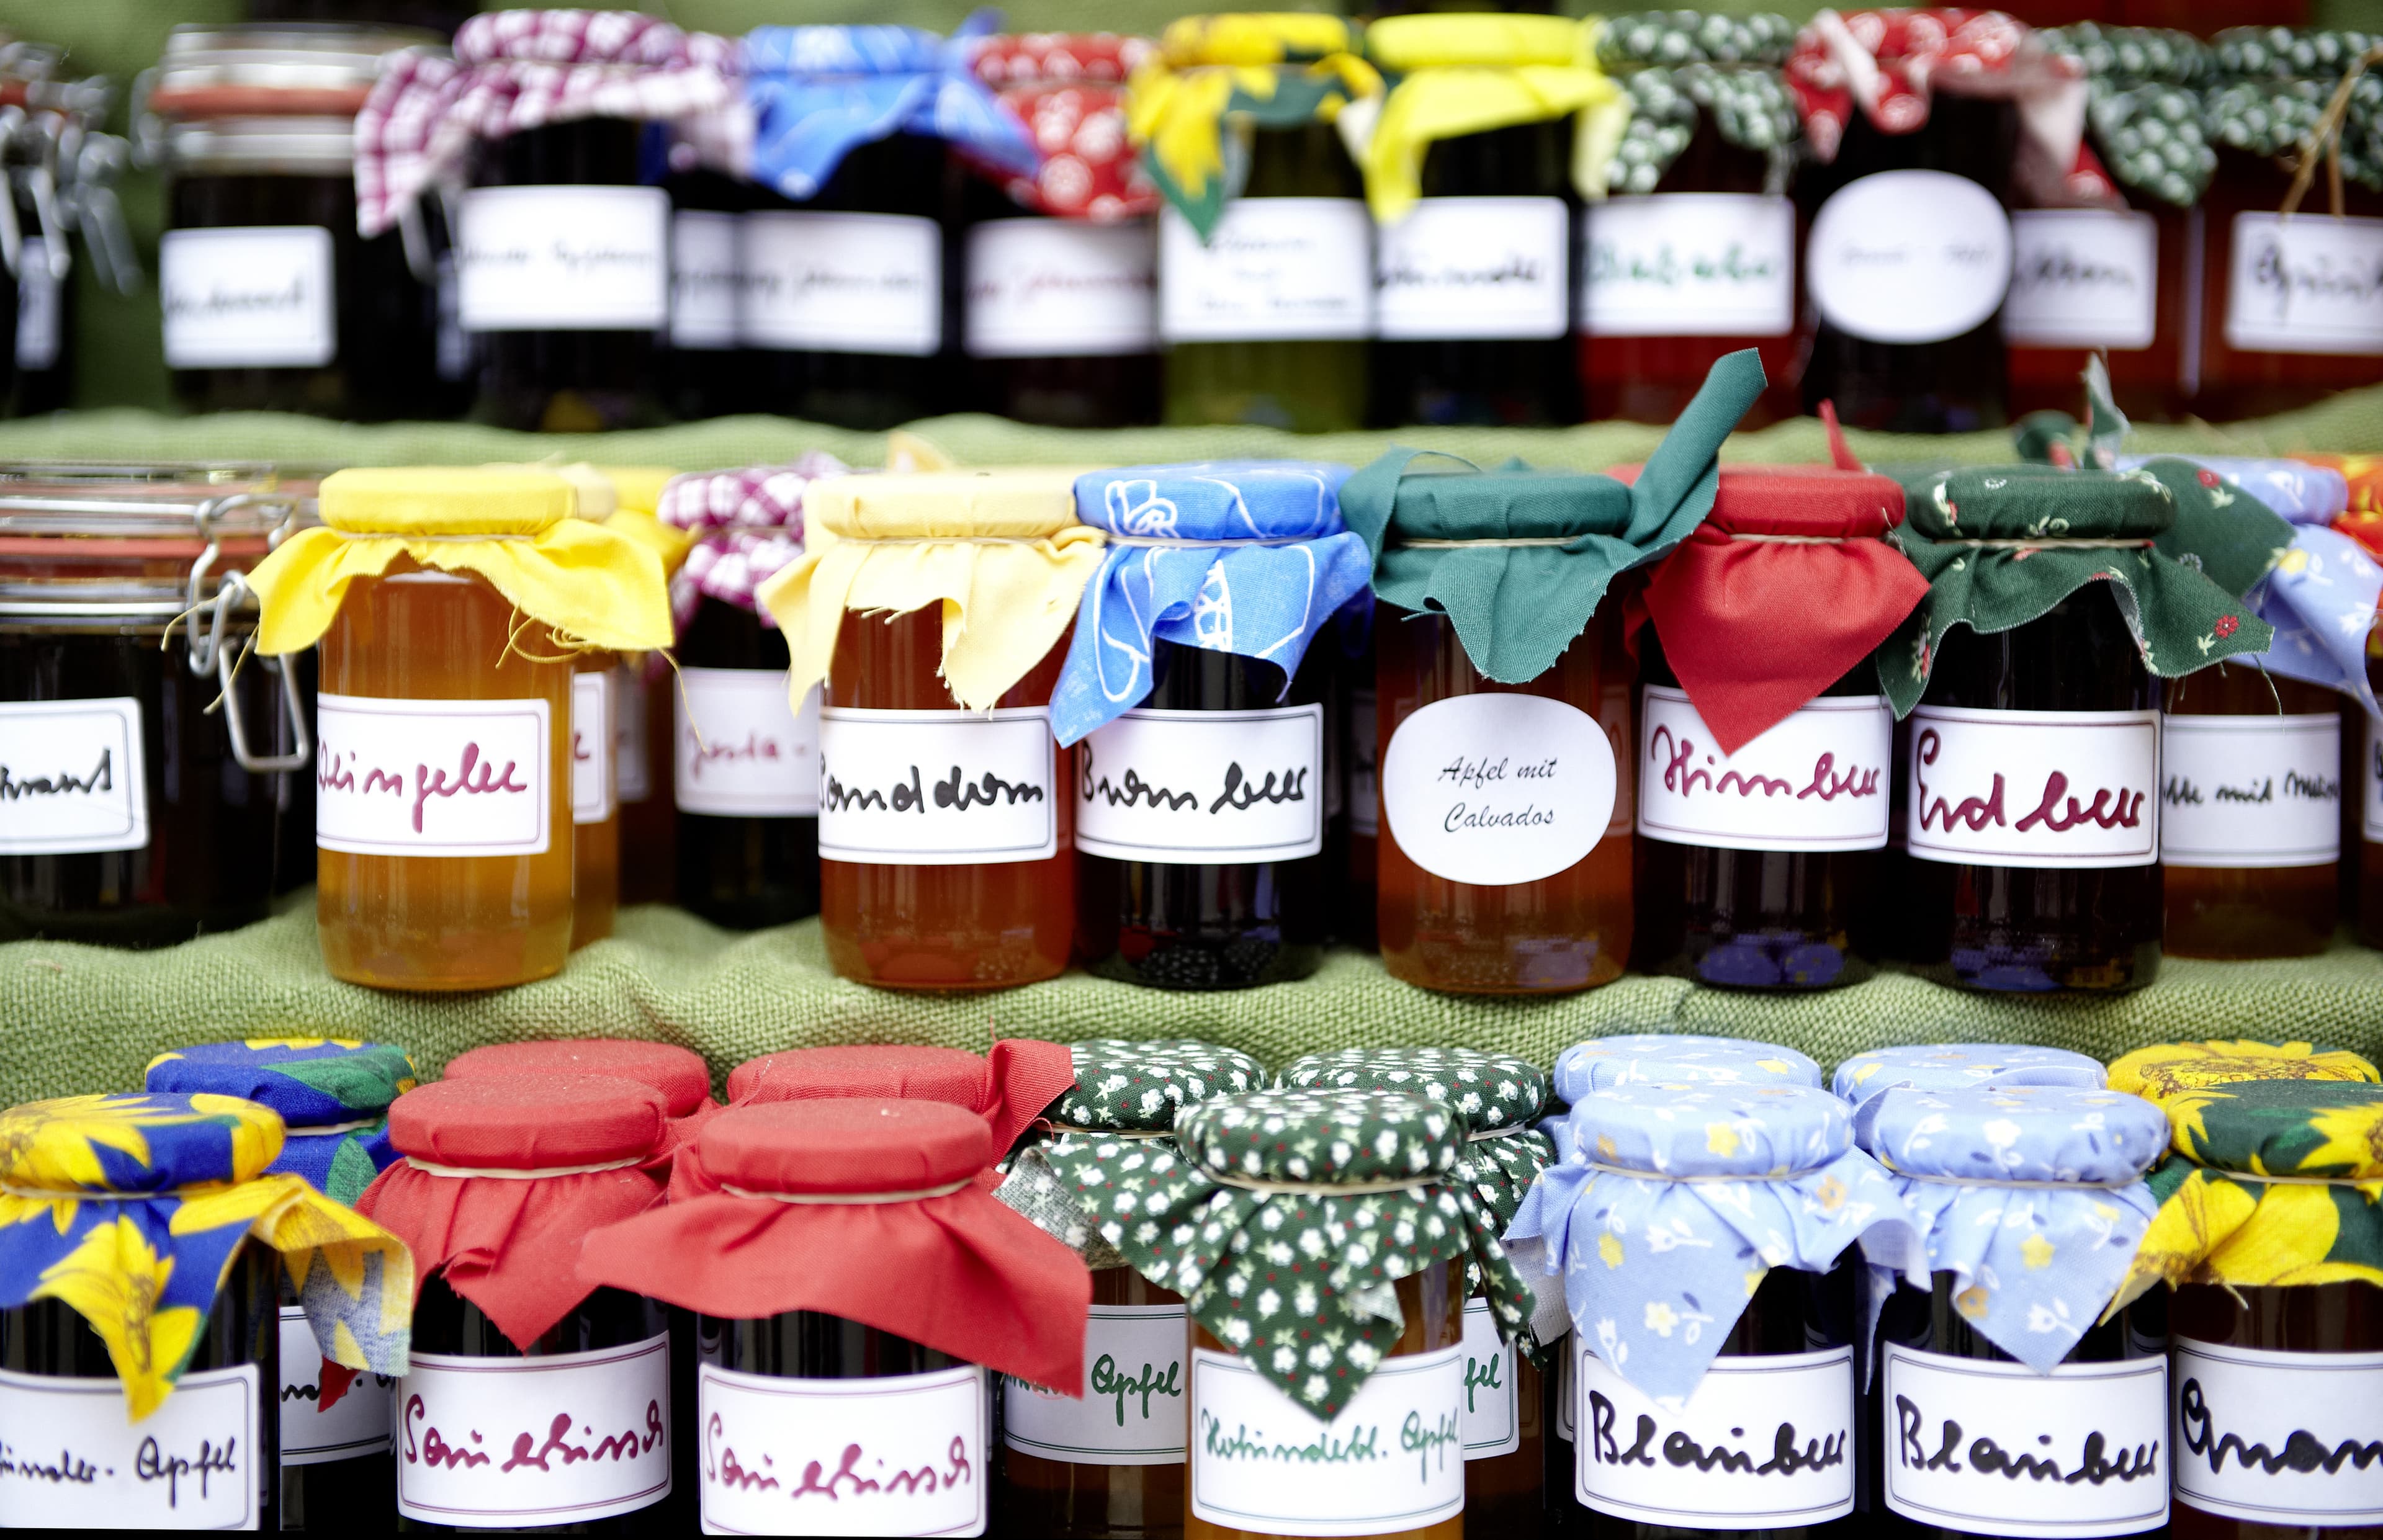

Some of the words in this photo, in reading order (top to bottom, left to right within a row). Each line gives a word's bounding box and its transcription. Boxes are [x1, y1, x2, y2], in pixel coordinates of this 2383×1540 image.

[1438, 755, 1509, 789] Apfel
[1517, 757, 1558, 779] mit
[1916, 727, 2147, 833] Erdbeer
[1444, 802, 1556, 833] Calvados
[1091, 1354, 1182, 1426] Apfel
[1464, 1353, 1502, 1413] fel
[135, 1435, 236, 1508] Apfel
[1401, 1407, 1458, 1485] Apfel
